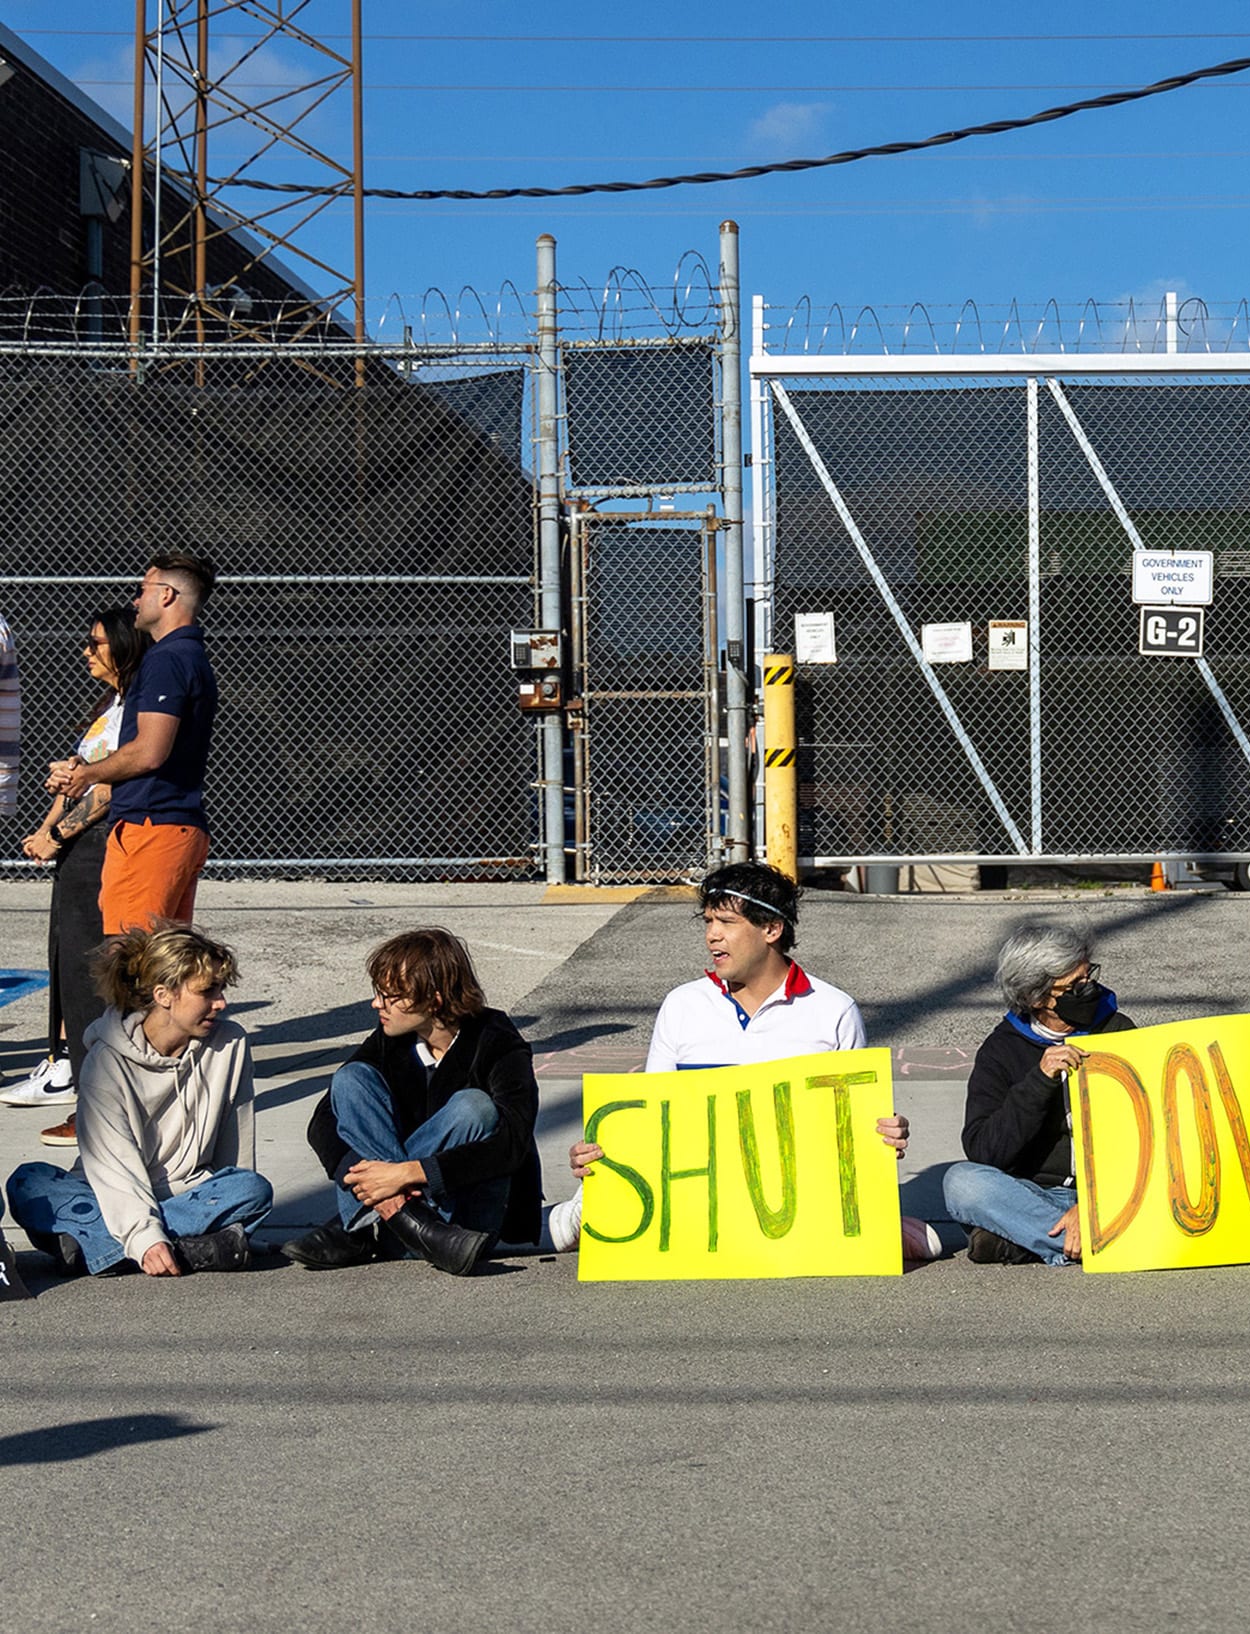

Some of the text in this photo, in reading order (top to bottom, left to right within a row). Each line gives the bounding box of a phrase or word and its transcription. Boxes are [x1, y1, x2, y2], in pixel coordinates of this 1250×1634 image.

[1142, 559, 1203, 568] GOVERNMENT
[1152, 572, 1194, 582] VEHICLES
[1161, 586, 1183, 595] ONLY
[1147, 616, 1197, 646] G-2
[583, 1071, 877, 1252] SHUT
